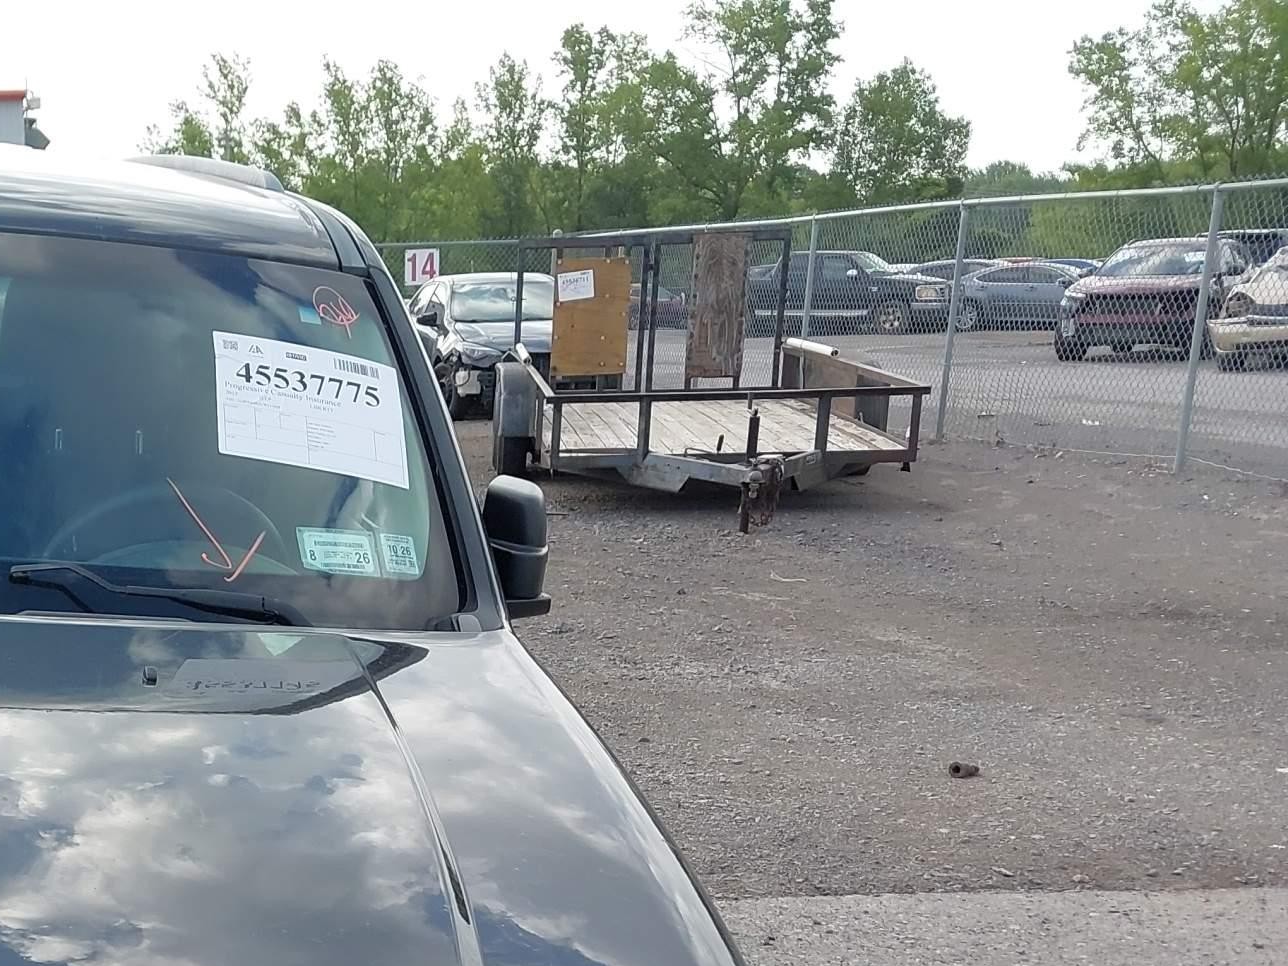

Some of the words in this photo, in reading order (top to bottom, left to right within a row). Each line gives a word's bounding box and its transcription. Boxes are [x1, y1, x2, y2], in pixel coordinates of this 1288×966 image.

[407, 252, 437, 281] 14
[235, 362, 381, 408] 45537775
[355, 552, 371, 565] 26
